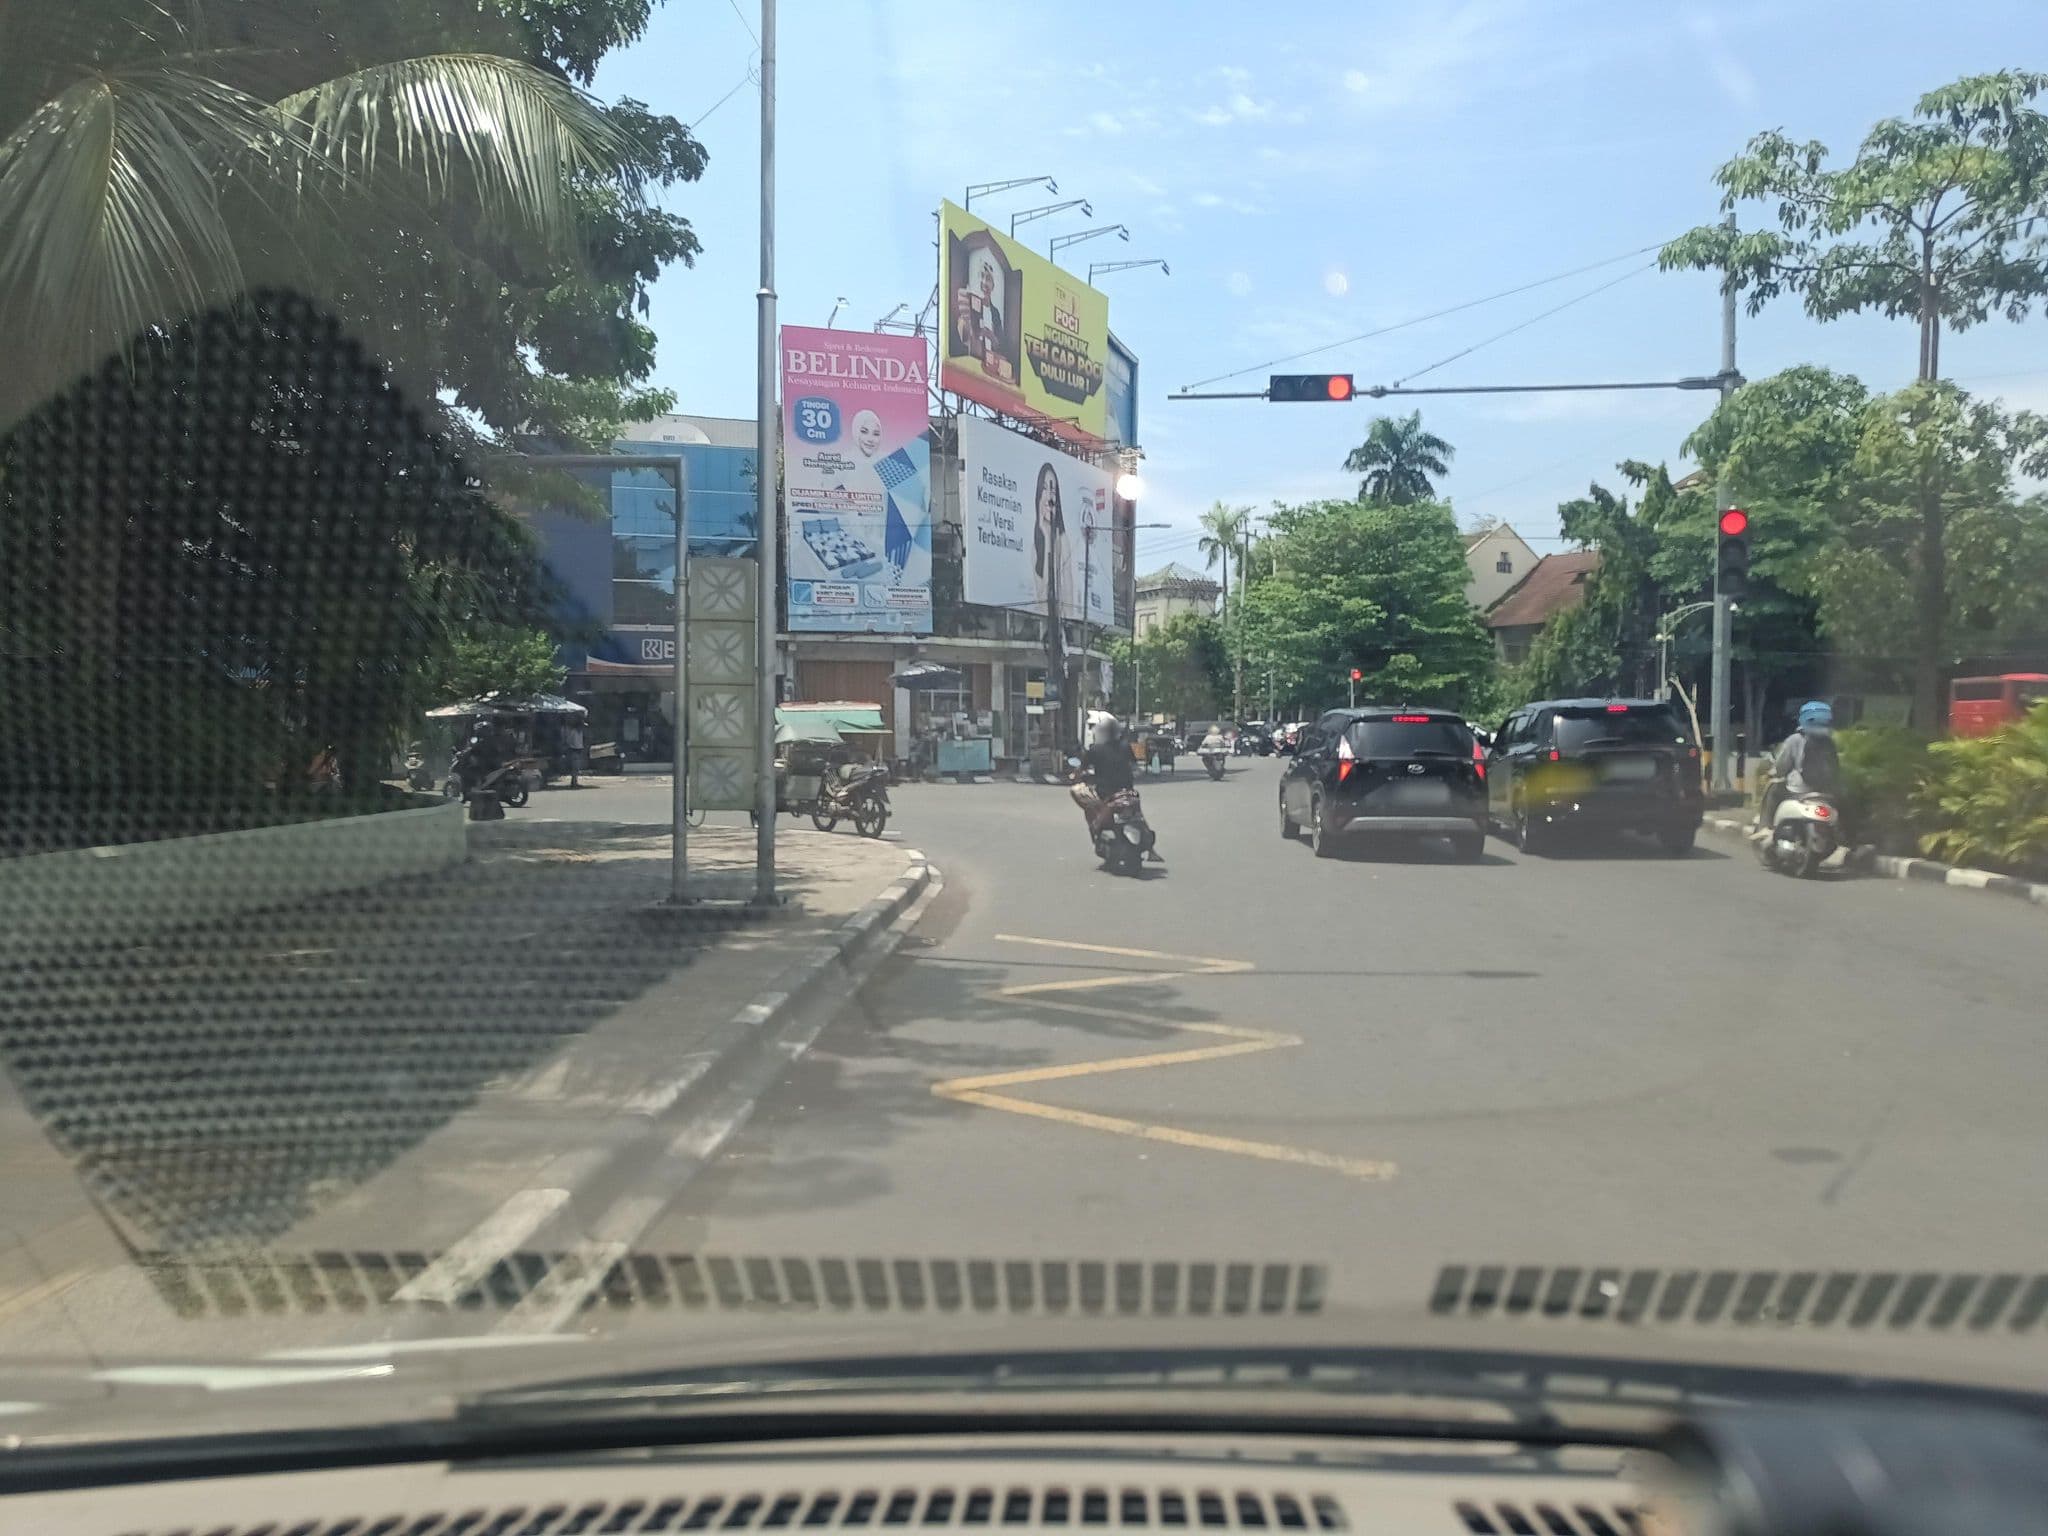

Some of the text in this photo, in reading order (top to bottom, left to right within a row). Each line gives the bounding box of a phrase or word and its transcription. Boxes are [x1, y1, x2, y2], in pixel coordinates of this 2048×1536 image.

[1055, 310, 1078, 333] POCI
[786, 349, 925, 383] BELINDA
[1025, 336, 1103, 378] TEH CAP POCI
[1040, 361, 1065, 384] DULU
[842, 380, 881, 392] Keluarga
[801, 400, 830, 410] TINGGI
[802, 409, 832, 429] 30
[983, 466, 1017, 492] Rasakan
[977, 485, 1022, 514] Kemurnian
[993, 511, 1015, 532] Versi
[977, 526, 1024, 552] Terbaikmu!
